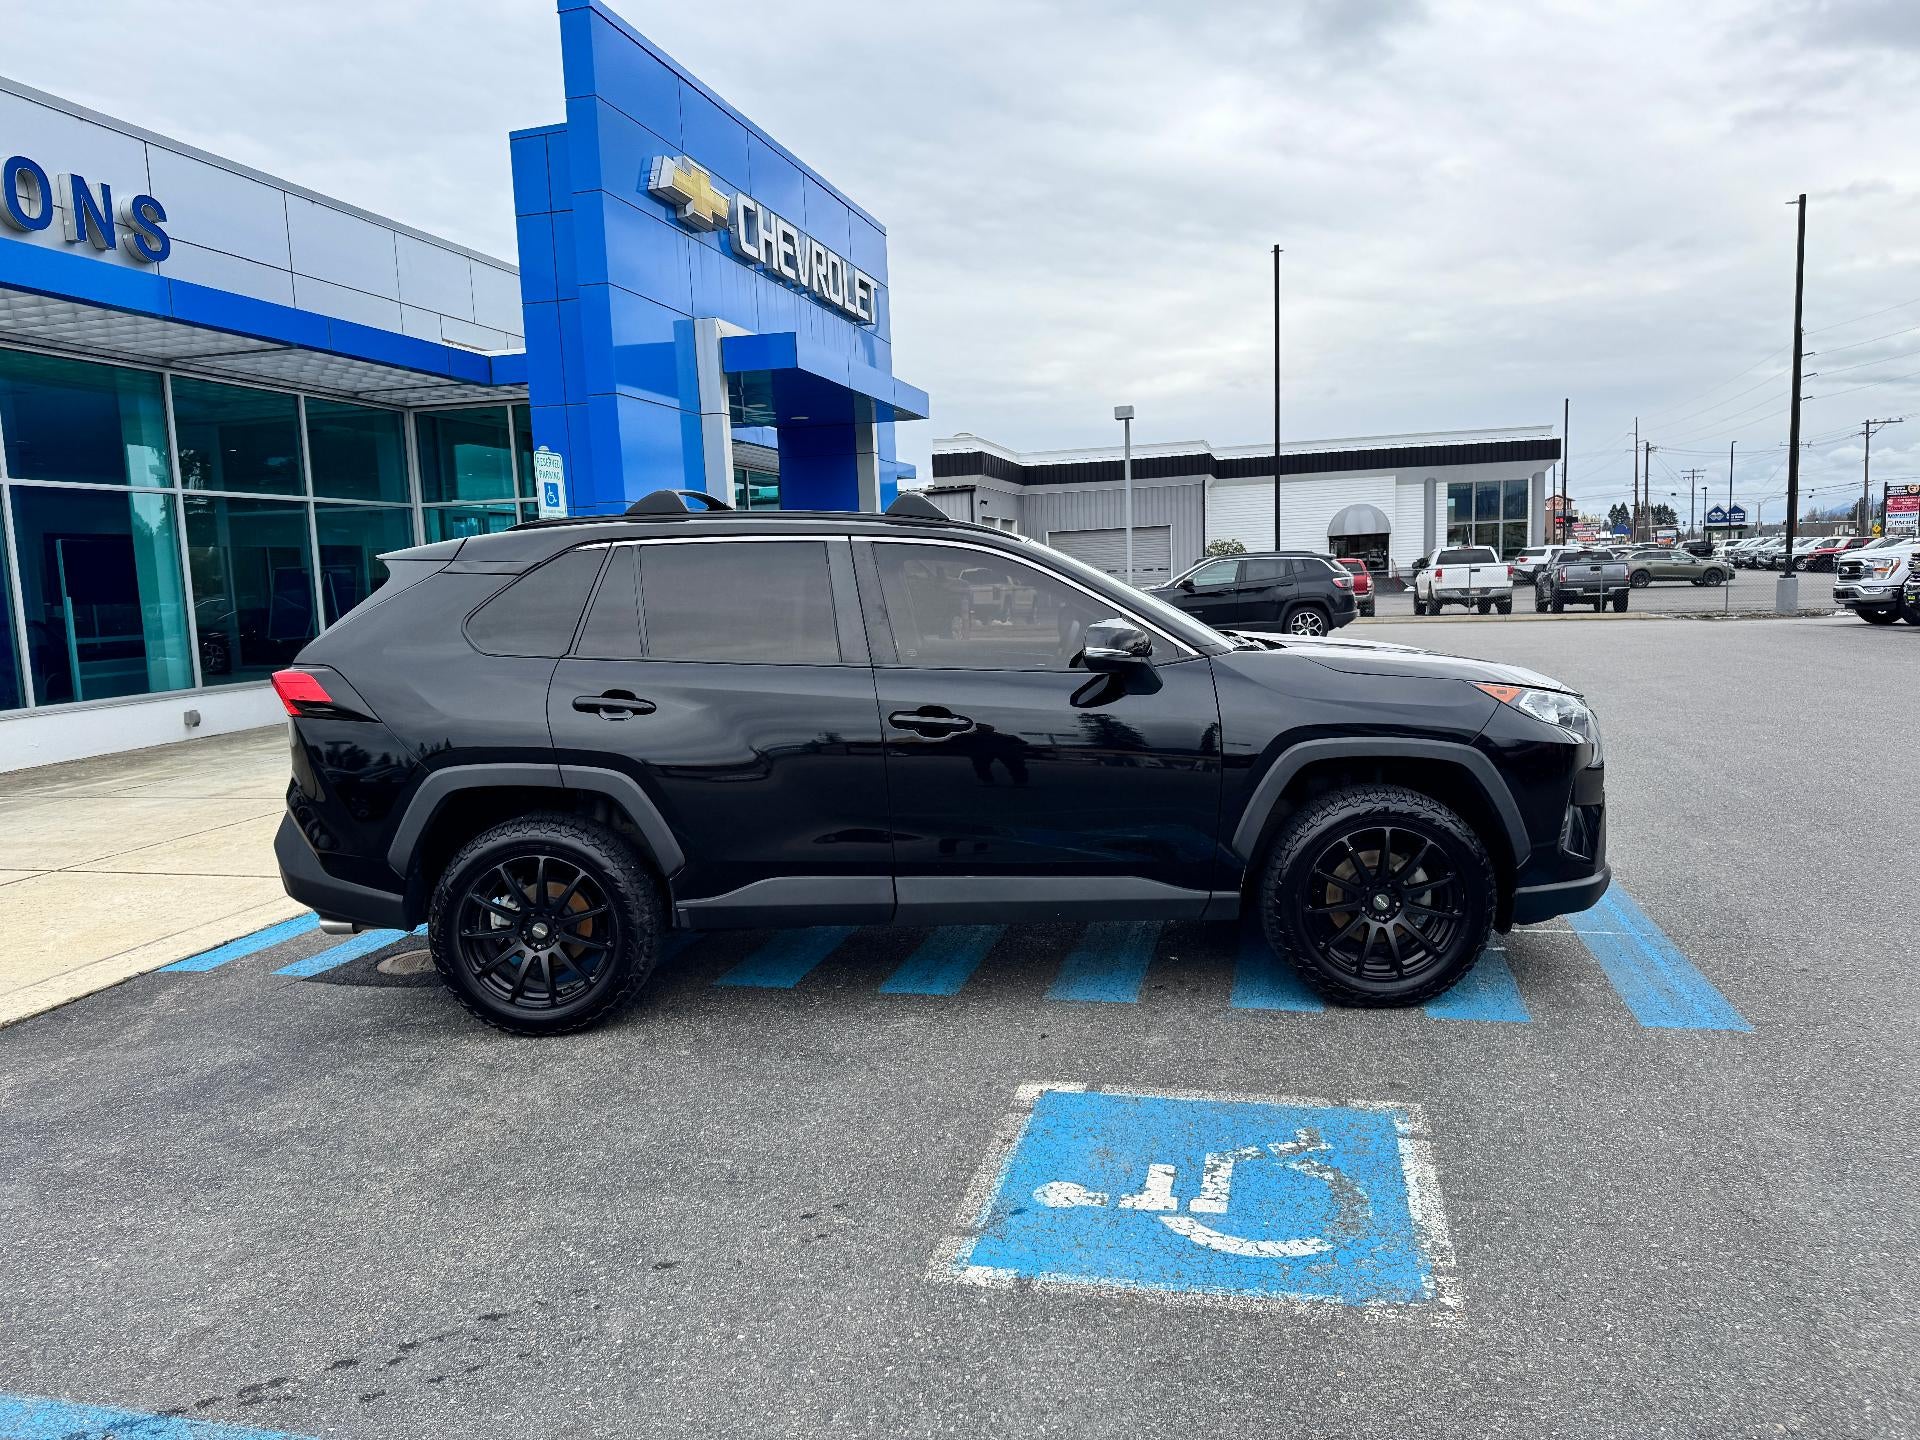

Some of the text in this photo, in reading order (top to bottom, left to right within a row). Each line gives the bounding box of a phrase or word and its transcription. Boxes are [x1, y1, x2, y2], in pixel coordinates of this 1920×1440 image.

[1, 155, 171, 263] ONS
[730, 192, 877, 325] CHEVROLET
[536, 456, 560, 468] RESERVED
[539, 470, 560, 480] PARKING
